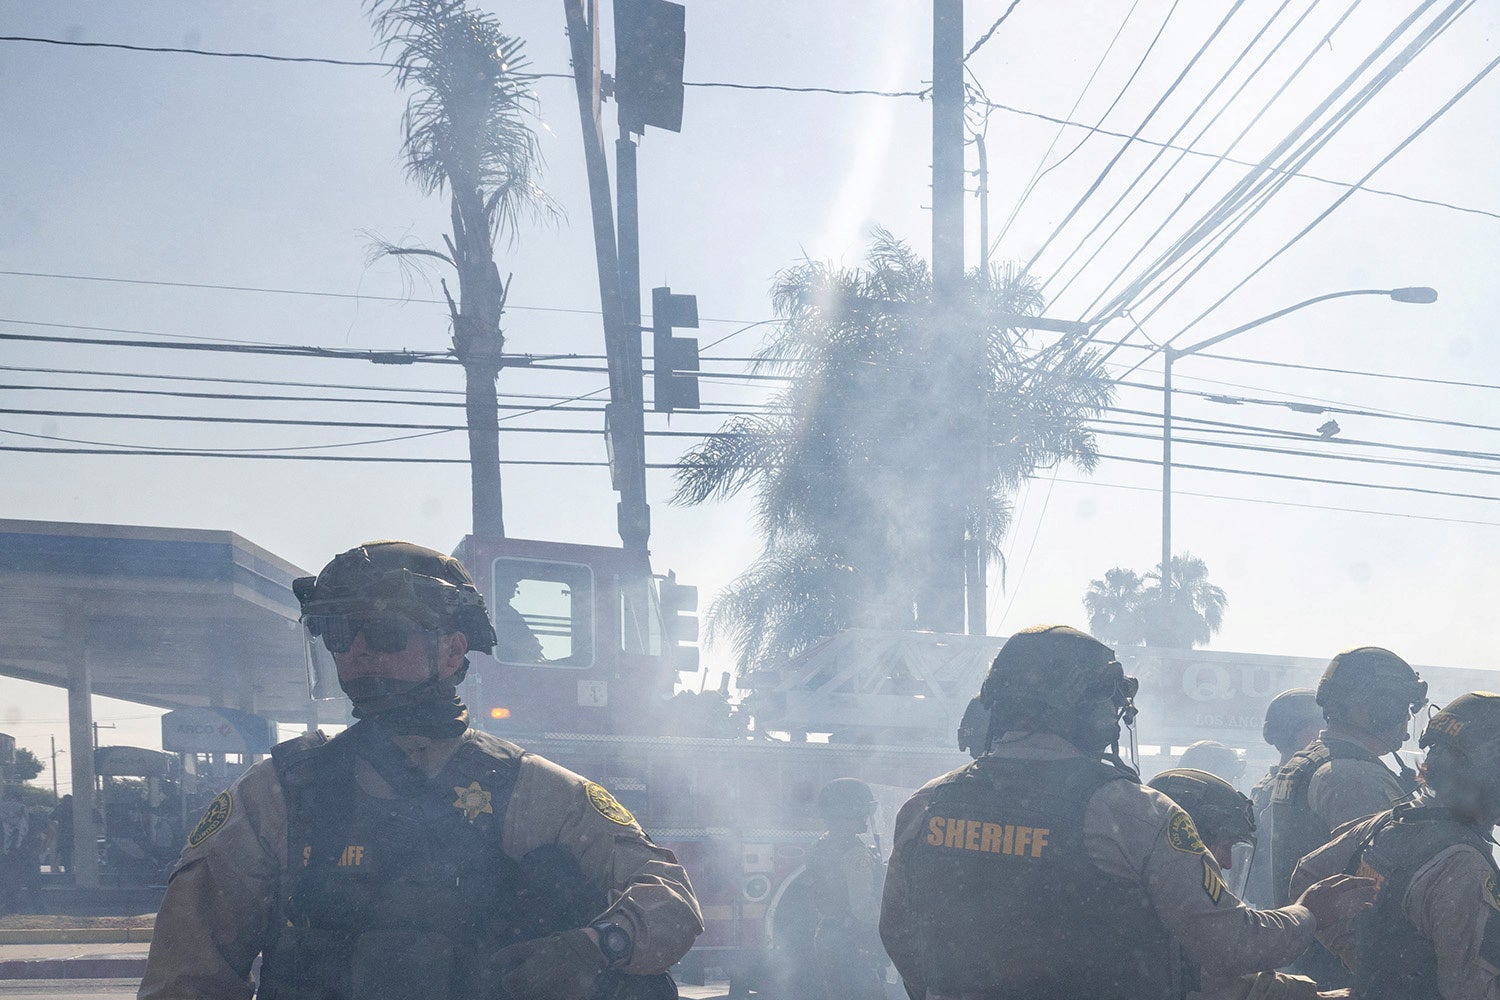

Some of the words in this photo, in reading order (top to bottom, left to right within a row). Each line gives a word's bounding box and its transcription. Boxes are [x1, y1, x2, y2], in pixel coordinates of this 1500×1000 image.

[1195, 714, 1222, 726] LOS
[178, 724, 214, 734] ARCO
[928, 817, 1048, 857] SHERIFF
